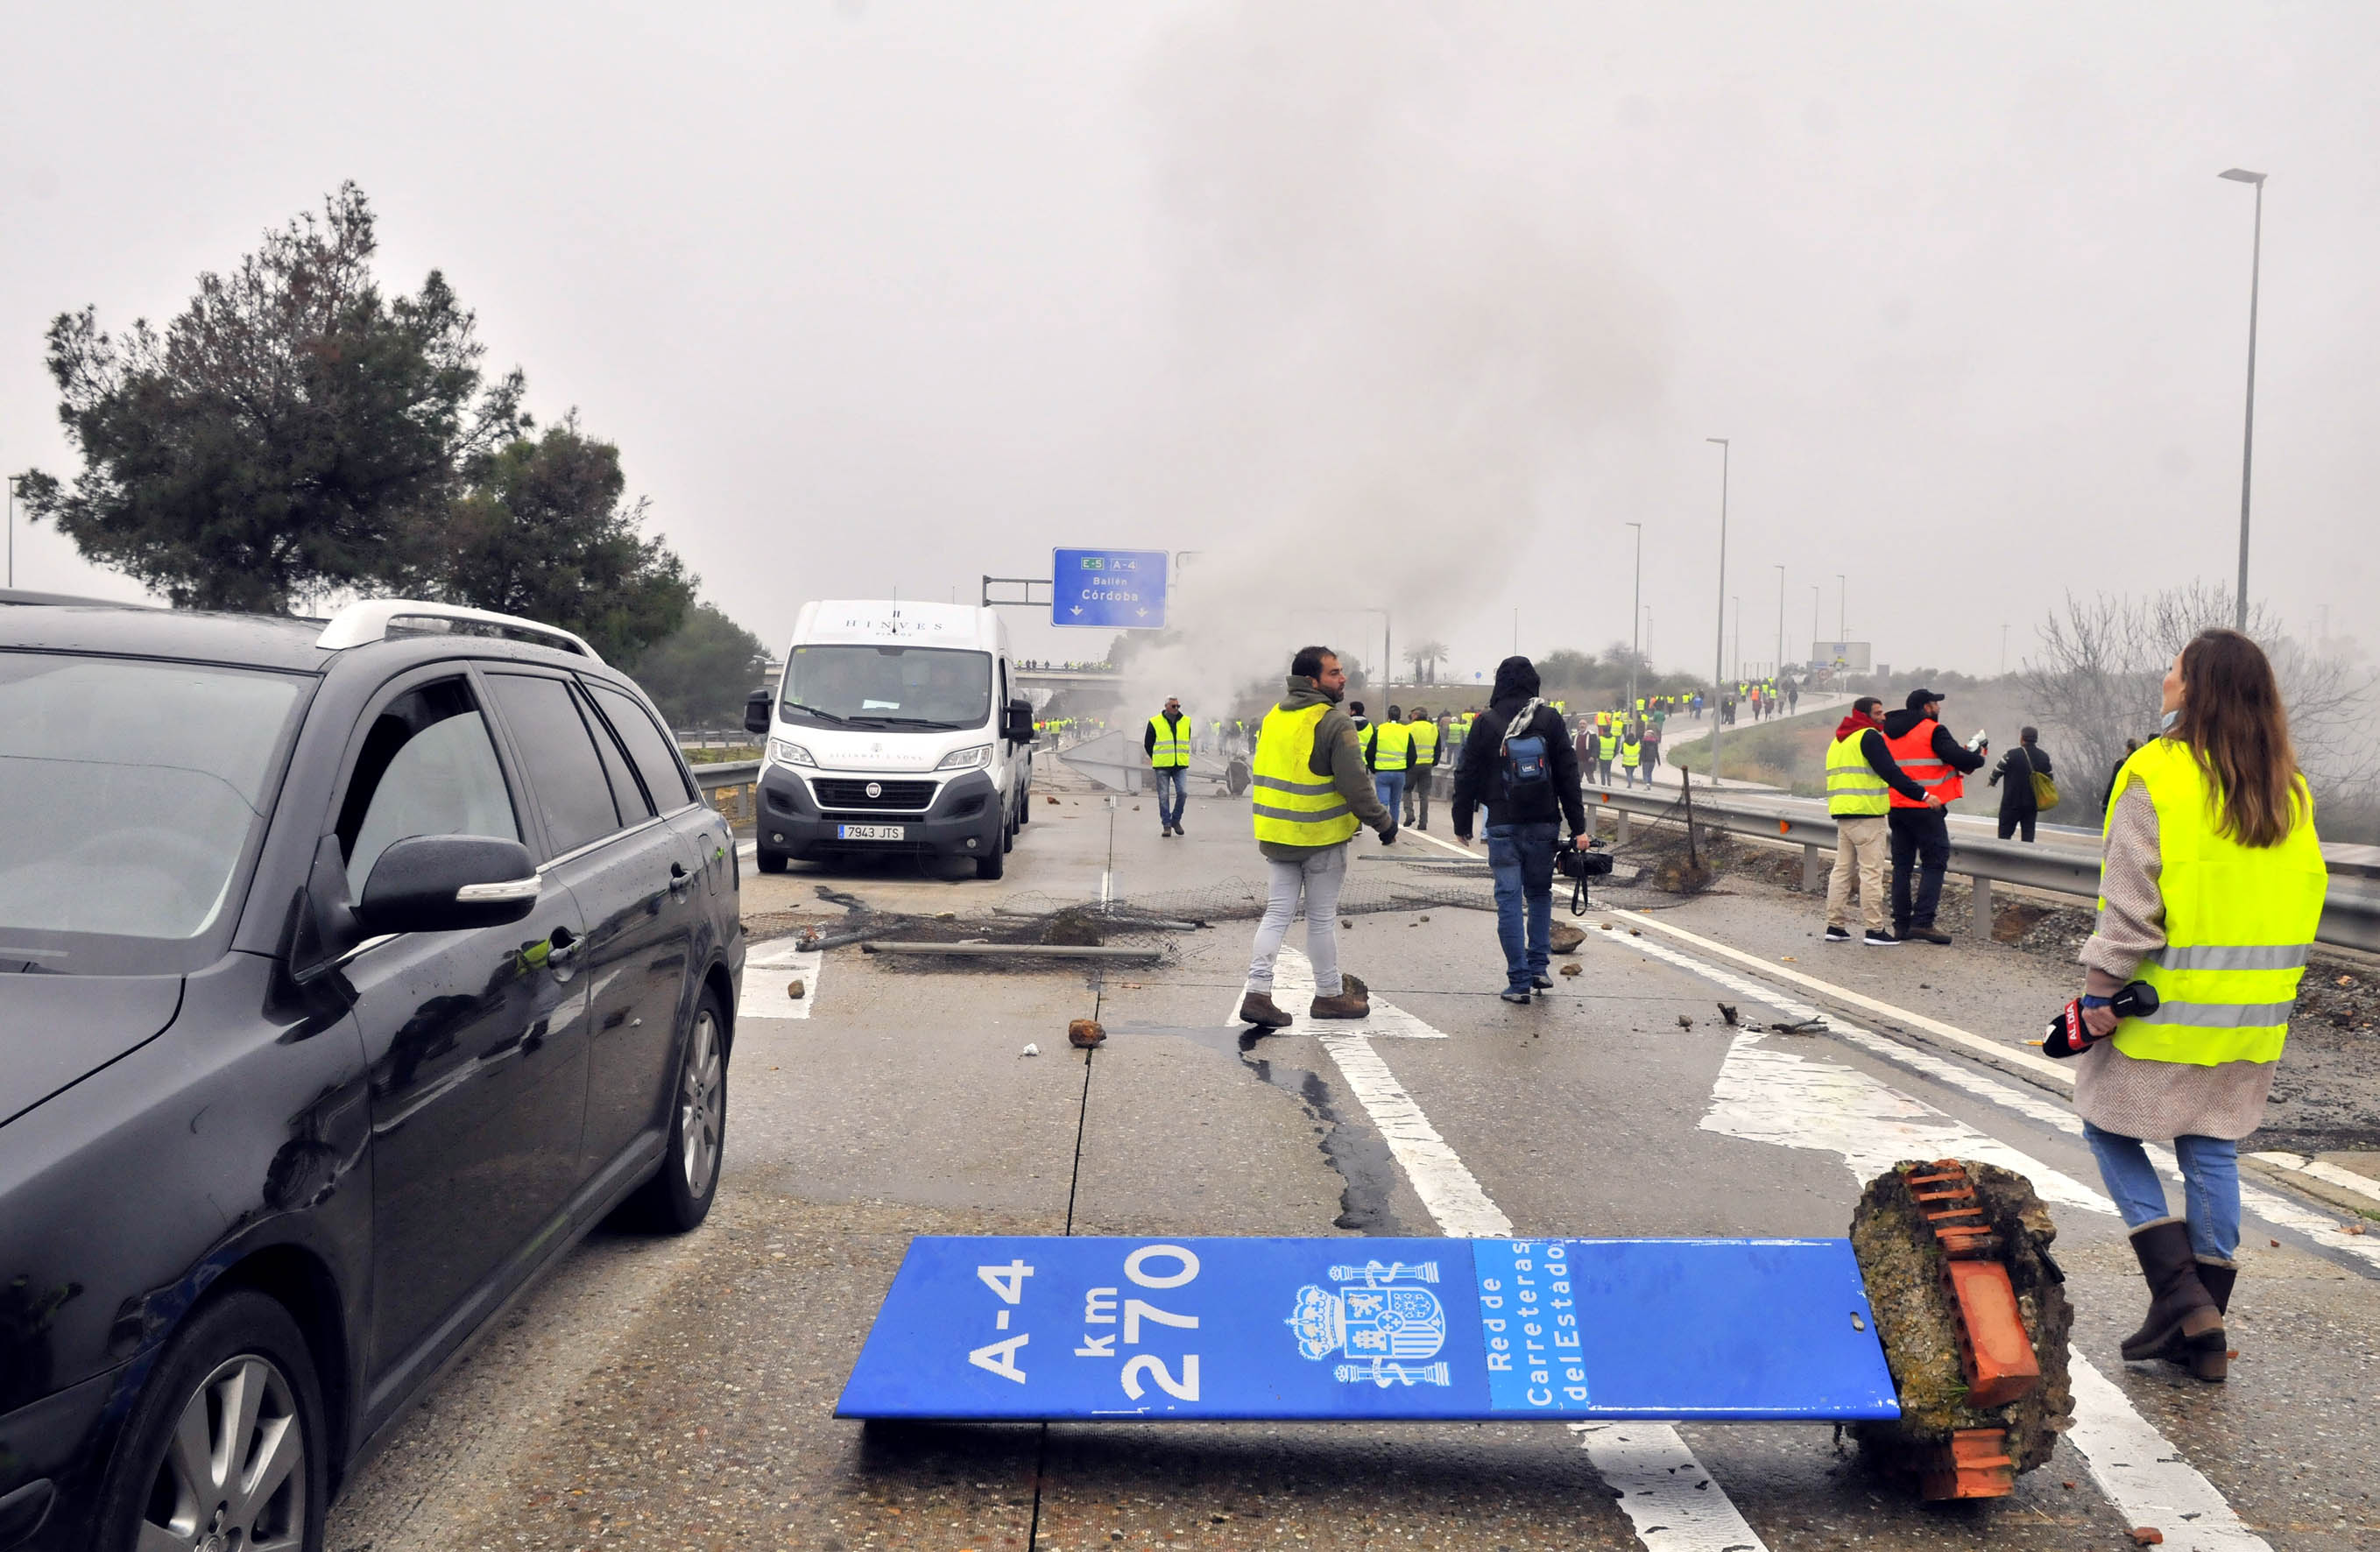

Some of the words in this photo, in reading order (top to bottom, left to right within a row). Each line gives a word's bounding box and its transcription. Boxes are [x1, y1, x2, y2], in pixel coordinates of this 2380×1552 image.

[1112, 561, 1136, 569] A-4
[1082, 589, 1139, 602] Córdoba
[845, 618, 943, 631] HINVES
[848, 826, 875, 838] 7943
[879, 828, 899, 839] JTS
[2069, 1024, 2077, 1040] AL
[1480, 1278, 1503, 1309] de
[1544, 1246, 1580, 1347] Estado
[968, 1259, 1035, 1385] A-4
[1074, 1287, 1118, 1357] km
[1120, 1244, 1200, 1401] 270
[1512, 1242, 1553, 1406] Carreteras
[1482, 1319, 1513, 1372] Red
[1557, 1357, 1587, 1401] del
